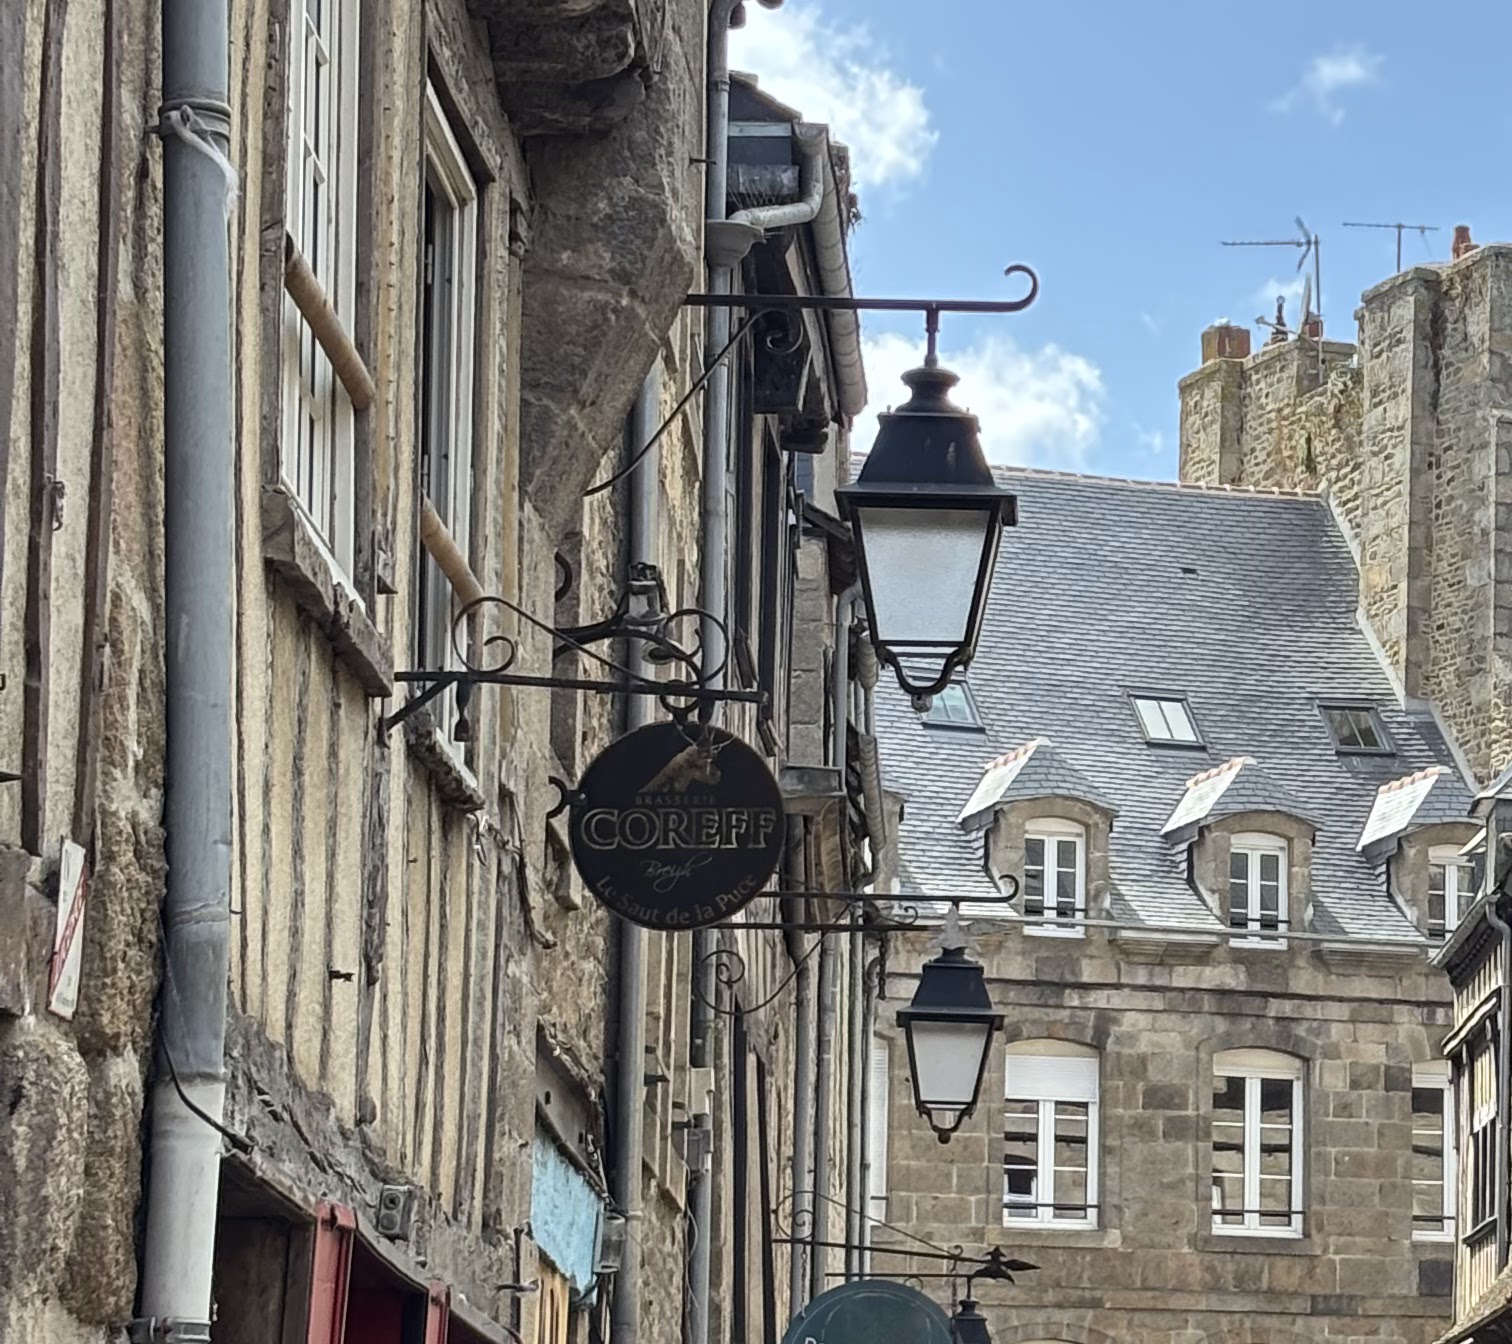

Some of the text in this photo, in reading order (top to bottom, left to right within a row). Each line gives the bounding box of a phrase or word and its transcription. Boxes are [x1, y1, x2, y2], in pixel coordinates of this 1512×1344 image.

[580, 807, 777, 850] COREFF
[595, 872, 757, 925] Le Saut de la Puce
